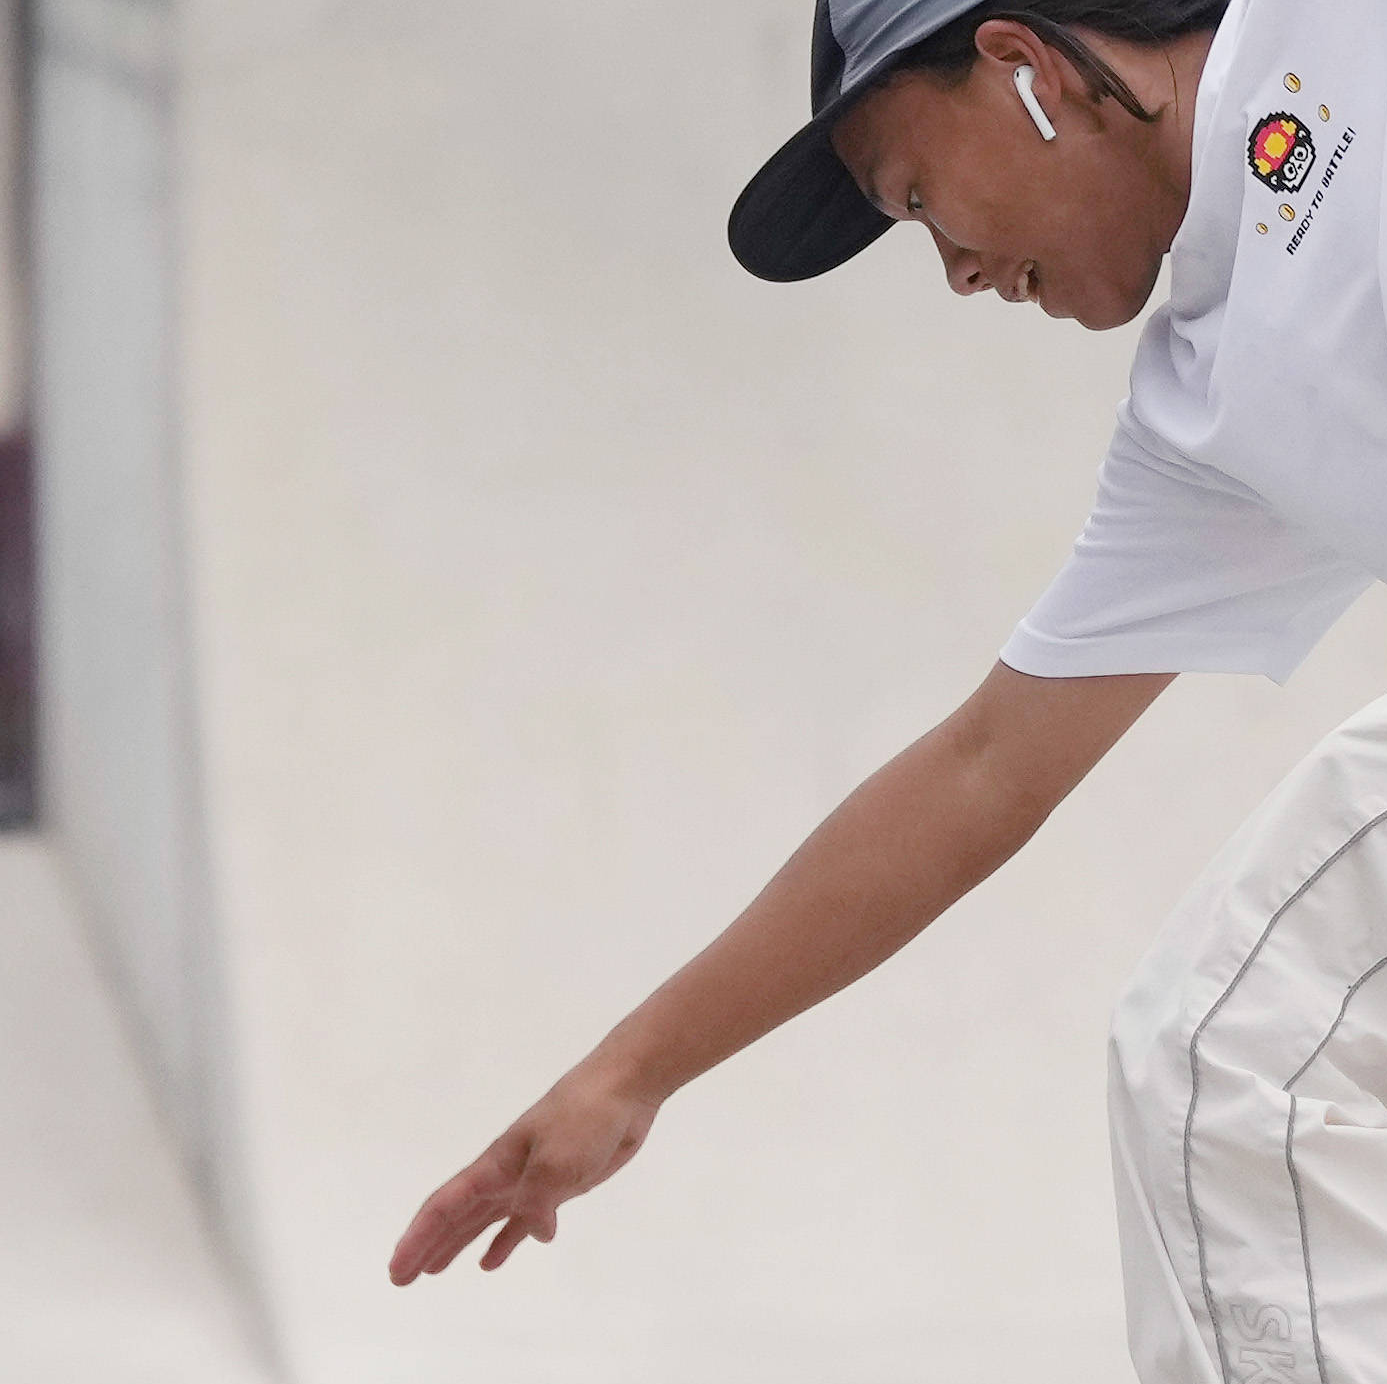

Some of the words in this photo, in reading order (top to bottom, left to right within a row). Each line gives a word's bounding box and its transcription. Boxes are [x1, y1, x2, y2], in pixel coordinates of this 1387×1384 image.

[1286, 209, 1314, 255] READY
[1311, 190, 1324, 210] TO
[1321, 126, 1357, 188] BATTLE!
